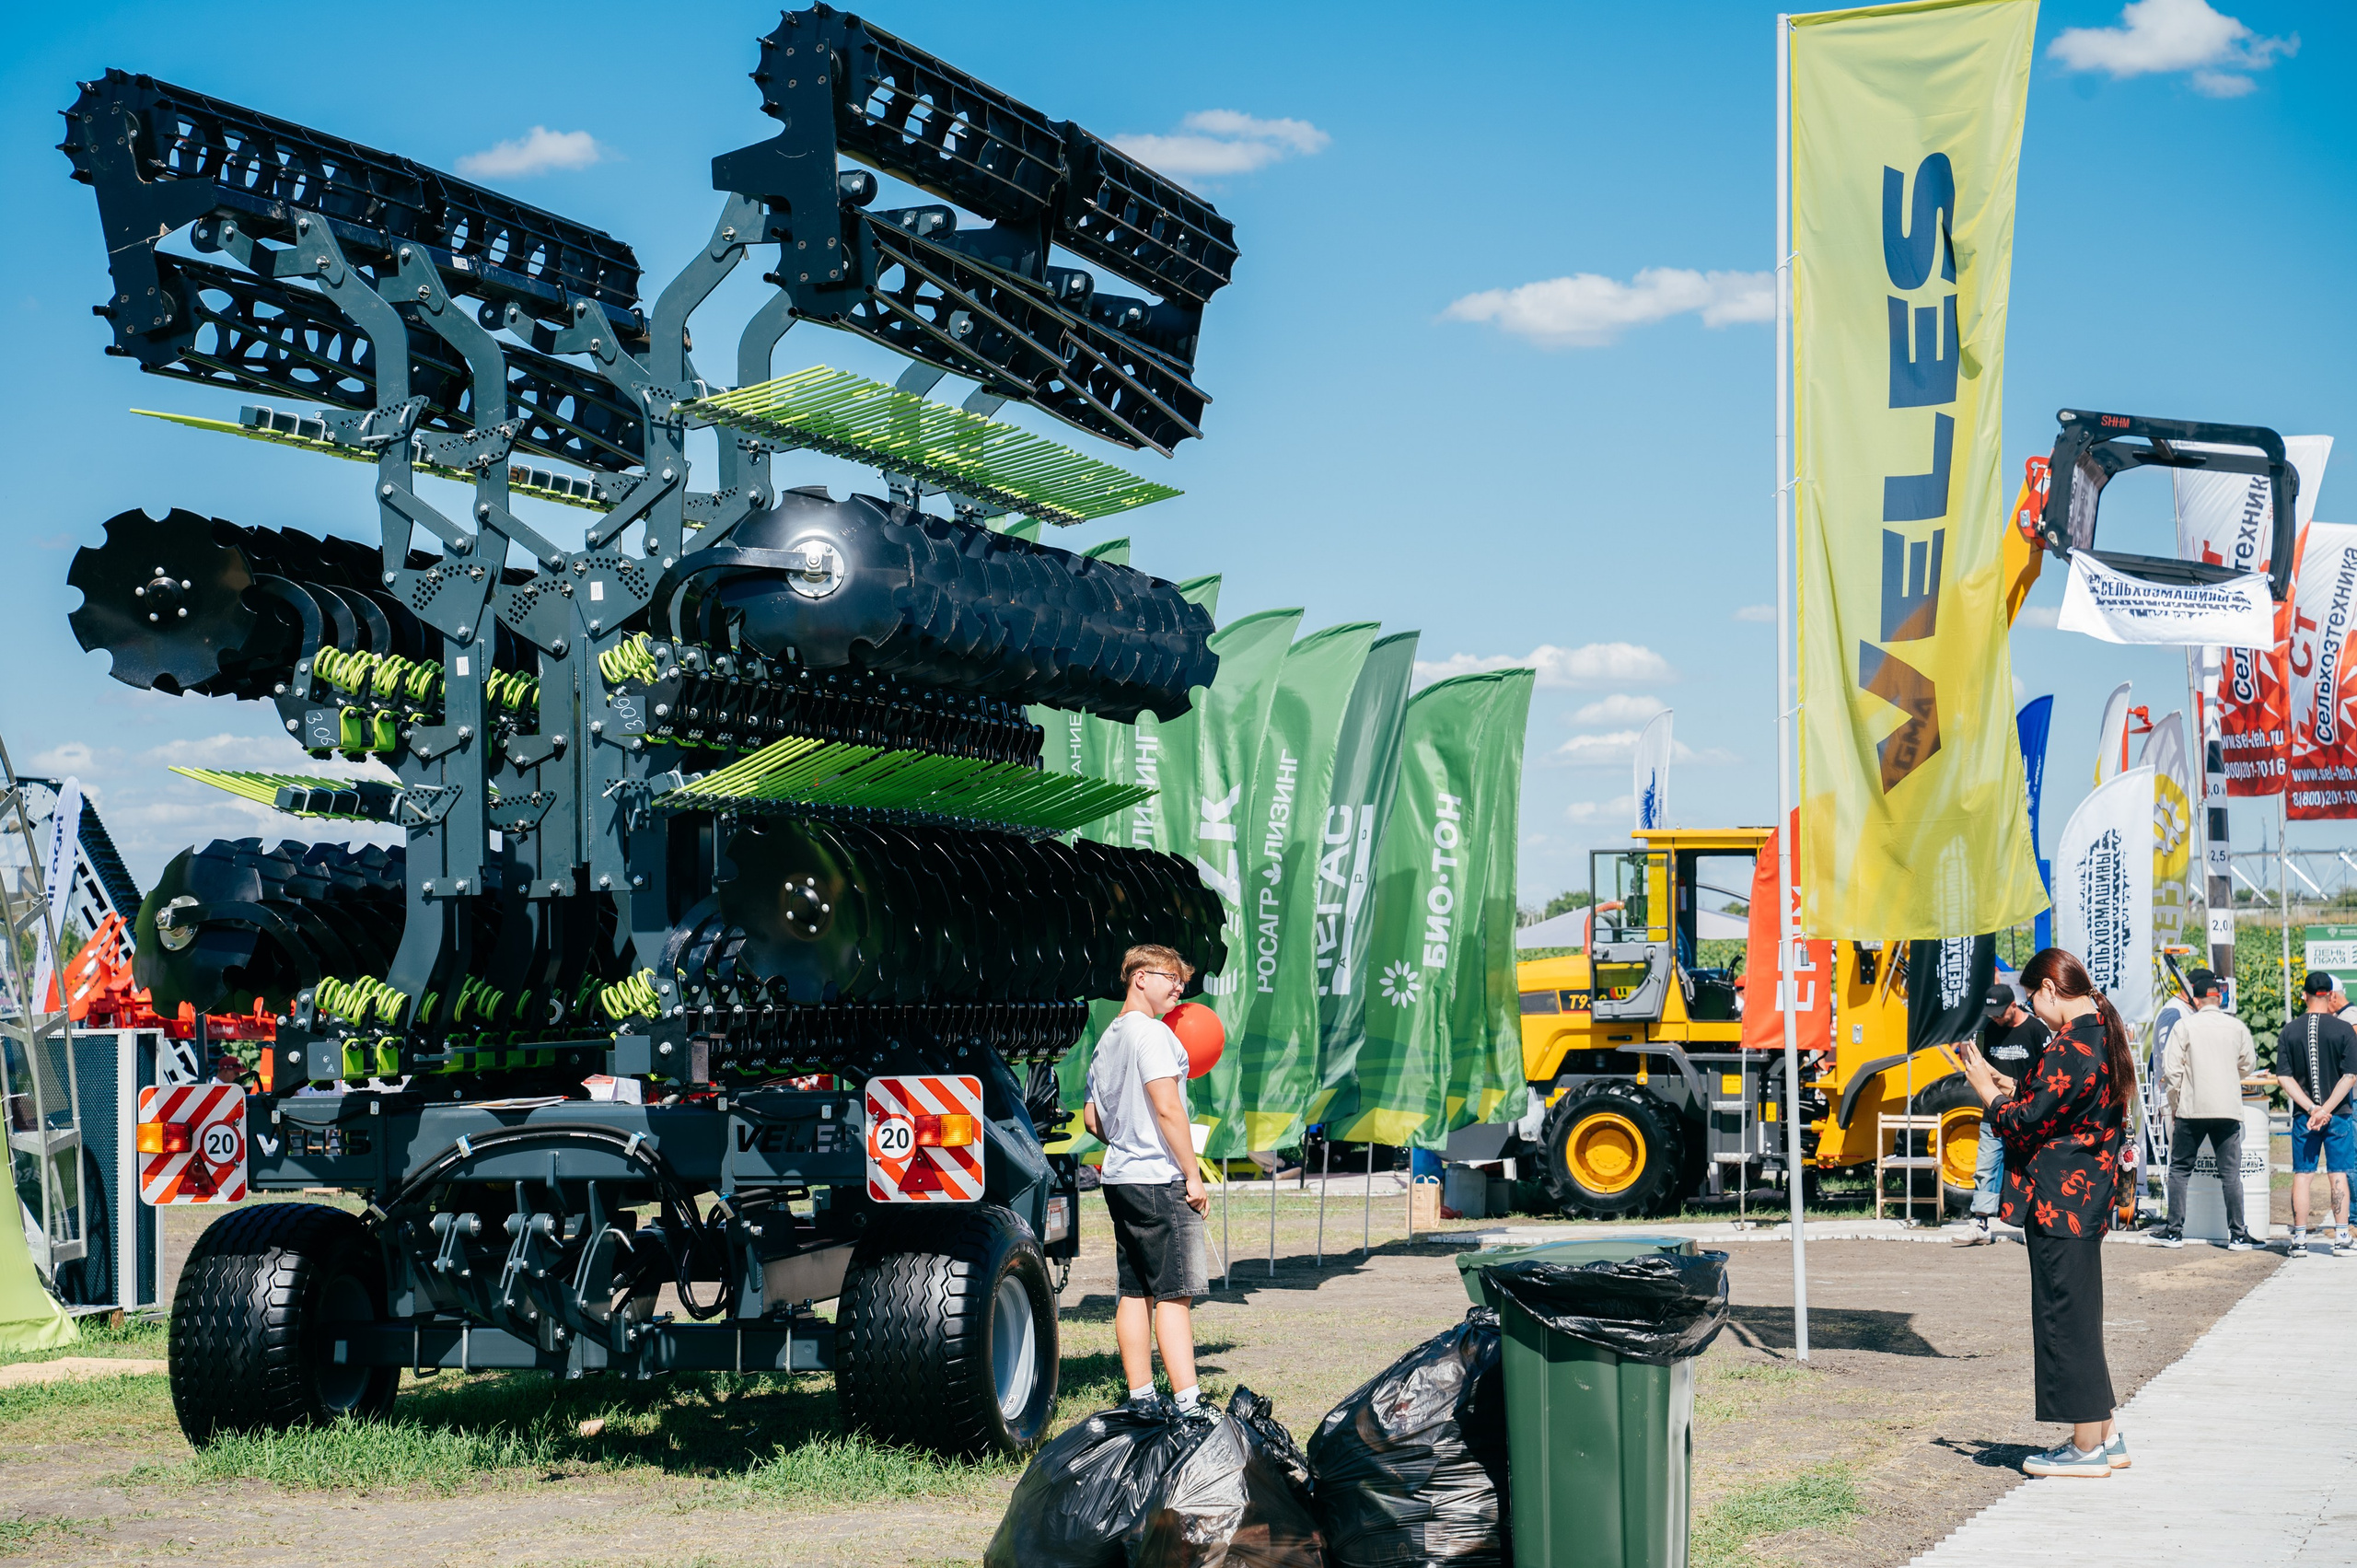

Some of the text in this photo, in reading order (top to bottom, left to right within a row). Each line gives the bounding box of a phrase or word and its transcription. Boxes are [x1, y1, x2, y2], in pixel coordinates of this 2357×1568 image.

[1858, 152, 1960, 796] VELES
[306, 712, 336, 746] 3.06
[613, 698, 644, 730] 3.06
[2211, 850, 2226, 864] 2,5
[2094, 852, 2111, 986] СЕЛЬХОЗМАШИНЫ
[2212, 920, 2228, 933] 2,0
[207, 1132, 235, 1156] 20
[737, 1124, 860, 1154] VELES
[881, 1127, 910, 1150] 20
